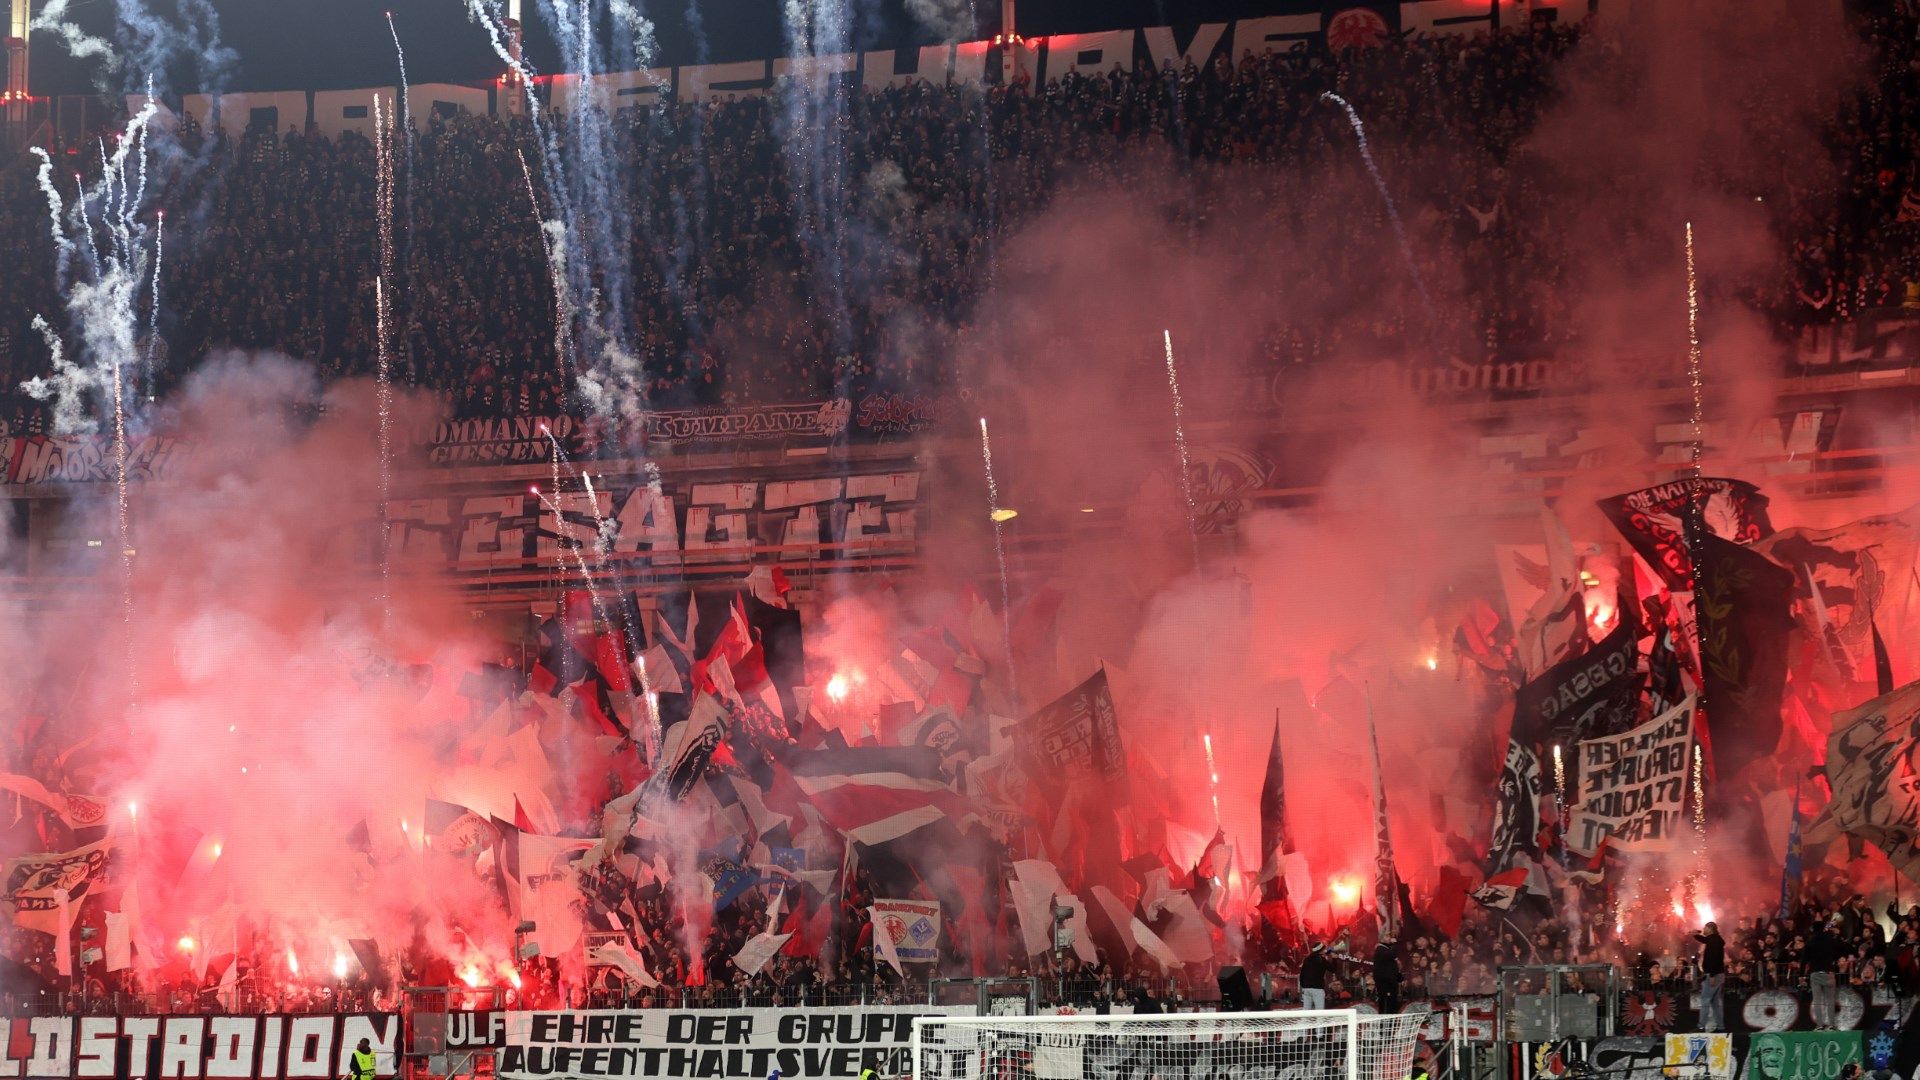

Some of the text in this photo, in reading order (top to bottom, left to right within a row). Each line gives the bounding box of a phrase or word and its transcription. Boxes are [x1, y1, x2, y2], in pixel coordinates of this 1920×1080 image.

[418, 411, 572, 443] OMMANDO
[647, 411, 819, 438] KUMPANE
[531, 1014, 946, 1044] EHRE DER GRUPPE
